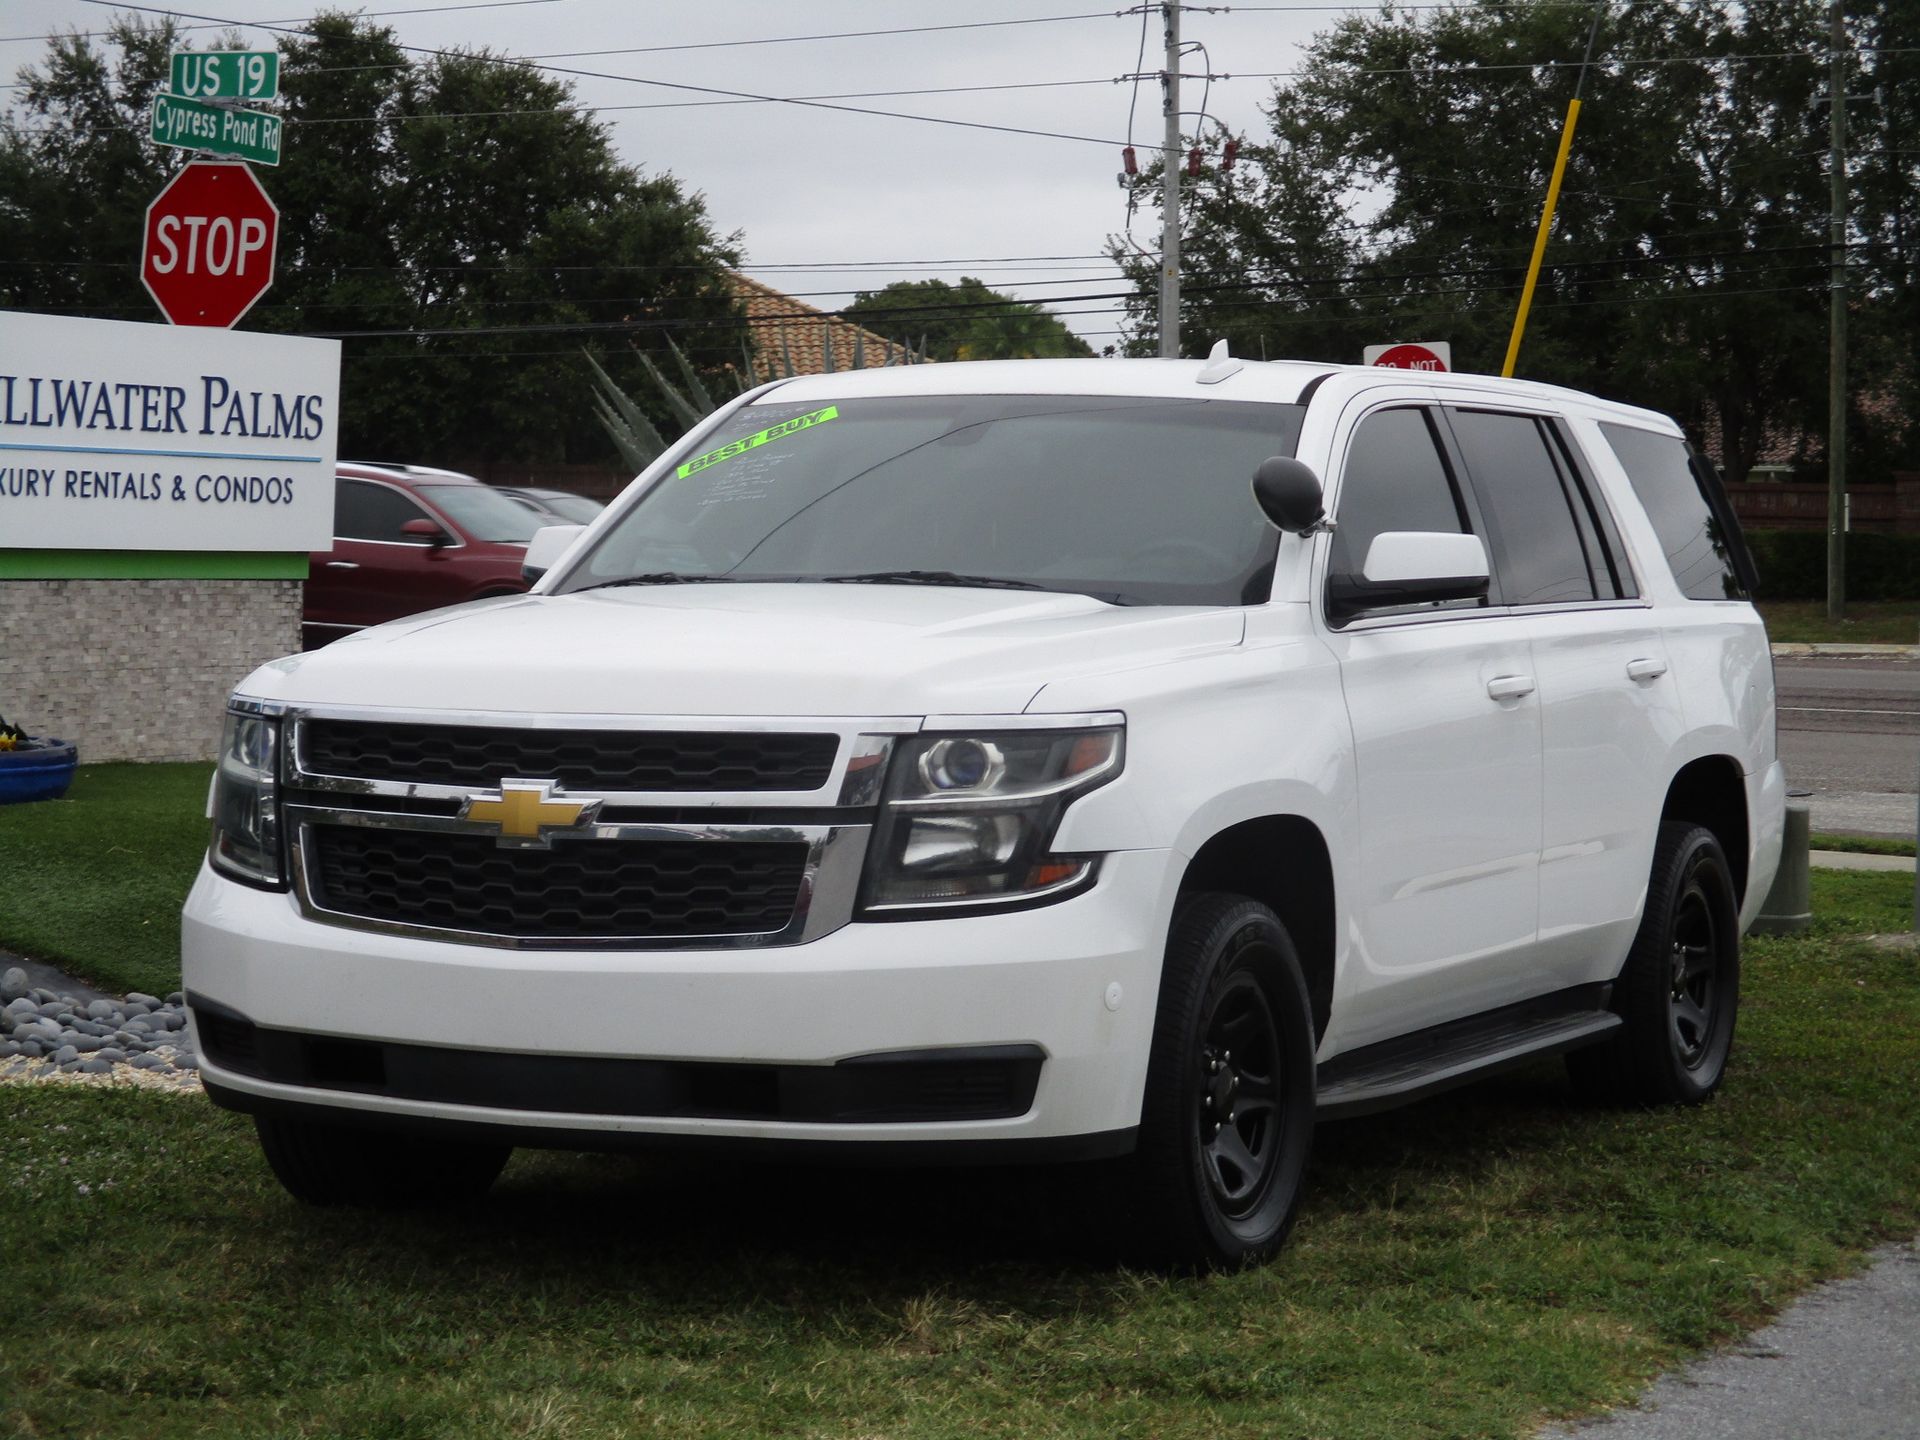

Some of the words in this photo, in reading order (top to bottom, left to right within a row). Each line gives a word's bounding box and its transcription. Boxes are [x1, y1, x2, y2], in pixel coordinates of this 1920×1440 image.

[181, 55, 221, 97] US
[237, 54, 266, 97] 19
[155, 97, 217, 141] Cypress
[222, 110, 258, 147] Pond
[261, 118, 280, 152] Rd
[152, 214, 267, 276] STOP
[1410, 359, 1438, 372] NOT
[0, 375, 188, 434] LLWATER
[687, 435, 759, 473] BEST
[765, 409, 829, 441] BUY
[64, 469, 162, 501] RENTALS
[171, 474, 187, 502] &
[195, 474, 294, 505] CONDOS
